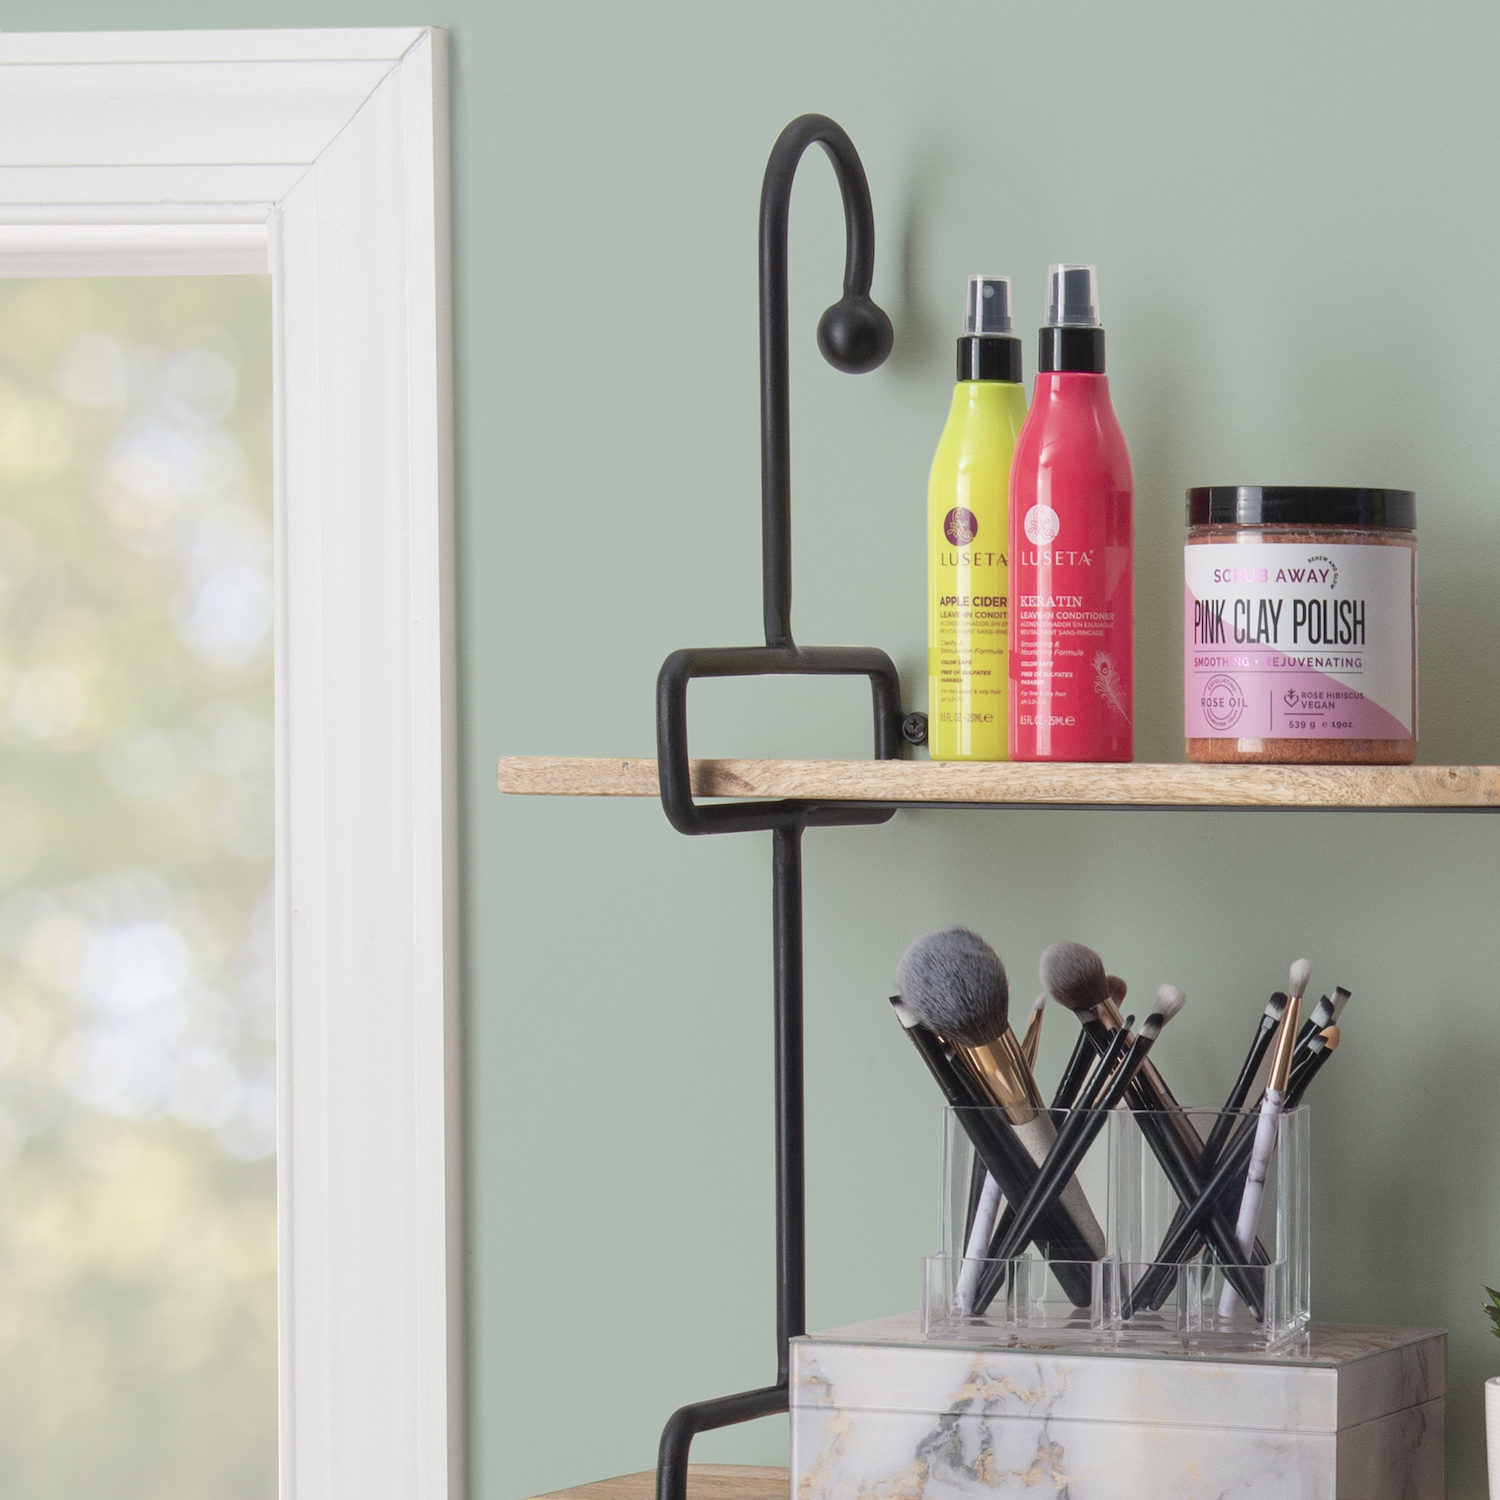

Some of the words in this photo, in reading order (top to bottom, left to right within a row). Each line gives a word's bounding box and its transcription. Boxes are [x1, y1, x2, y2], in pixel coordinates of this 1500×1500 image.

[942, 552, 1008, 566] LUSETA
[1021, 551, 1092, 566] LUSETA
[1328, 560, 1337, 571] AND
[1214, 568, 1269, 583] SCRUB
[1275, 568, 1330, 583] AWAY
[940, 596, 969, 607] APPLE
[972, 596, 1007, 607] CIDER
[1020, 596, 1083, 607] KERATIN
[1056, 612, 1114, 620] CONDITIONER
[1194, 599, 1226, 644] PINK
[1234, 599, 1283, 644] CLAY
[1293, 599, 1366, 645] POLISH
[1194, 657, 1250, 667] SMOOTHING
[1264, 657, 1362, 668] REJUVENATING
[1201, 698, 1224, 707] ROSE
[1229, 698, 1248, 707] OIL
